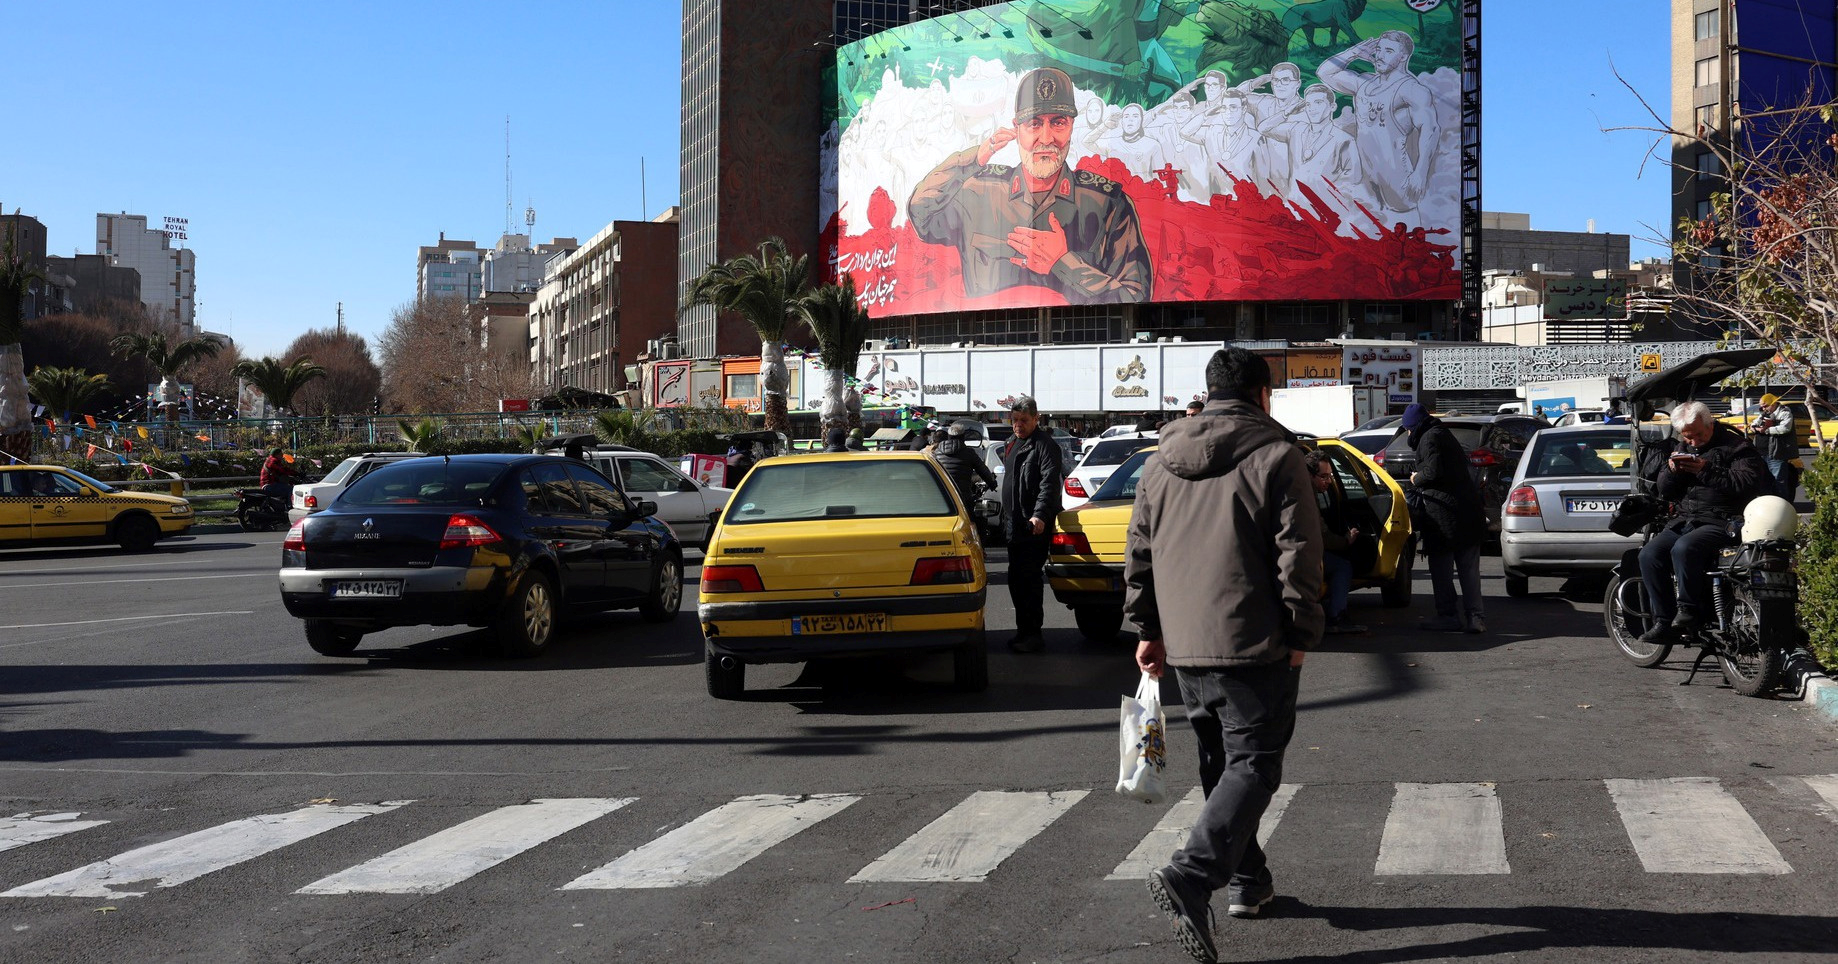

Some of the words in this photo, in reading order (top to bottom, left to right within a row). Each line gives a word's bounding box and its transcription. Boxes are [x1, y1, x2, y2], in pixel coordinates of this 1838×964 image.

[163, 216, 188, 224] TEHRAN
[162, 231, 187, 239] HOTEL
[882, 242, 898, 268] این
[1549, 281, 1585, 297] خرید
[1351, 347, 1377, 365] فود
[1379, 347, 1413, 362] فست
[1532, 357, 1551, 367] عصر
[1552, 356, 1568, 368] ولی
[1569, 356, 1600, 367] حضرت
[1601, 356, 1627, 367] میدان
[1365, 371, 1398, 386] آرام
[1589, 500, 1598, 511] ن
